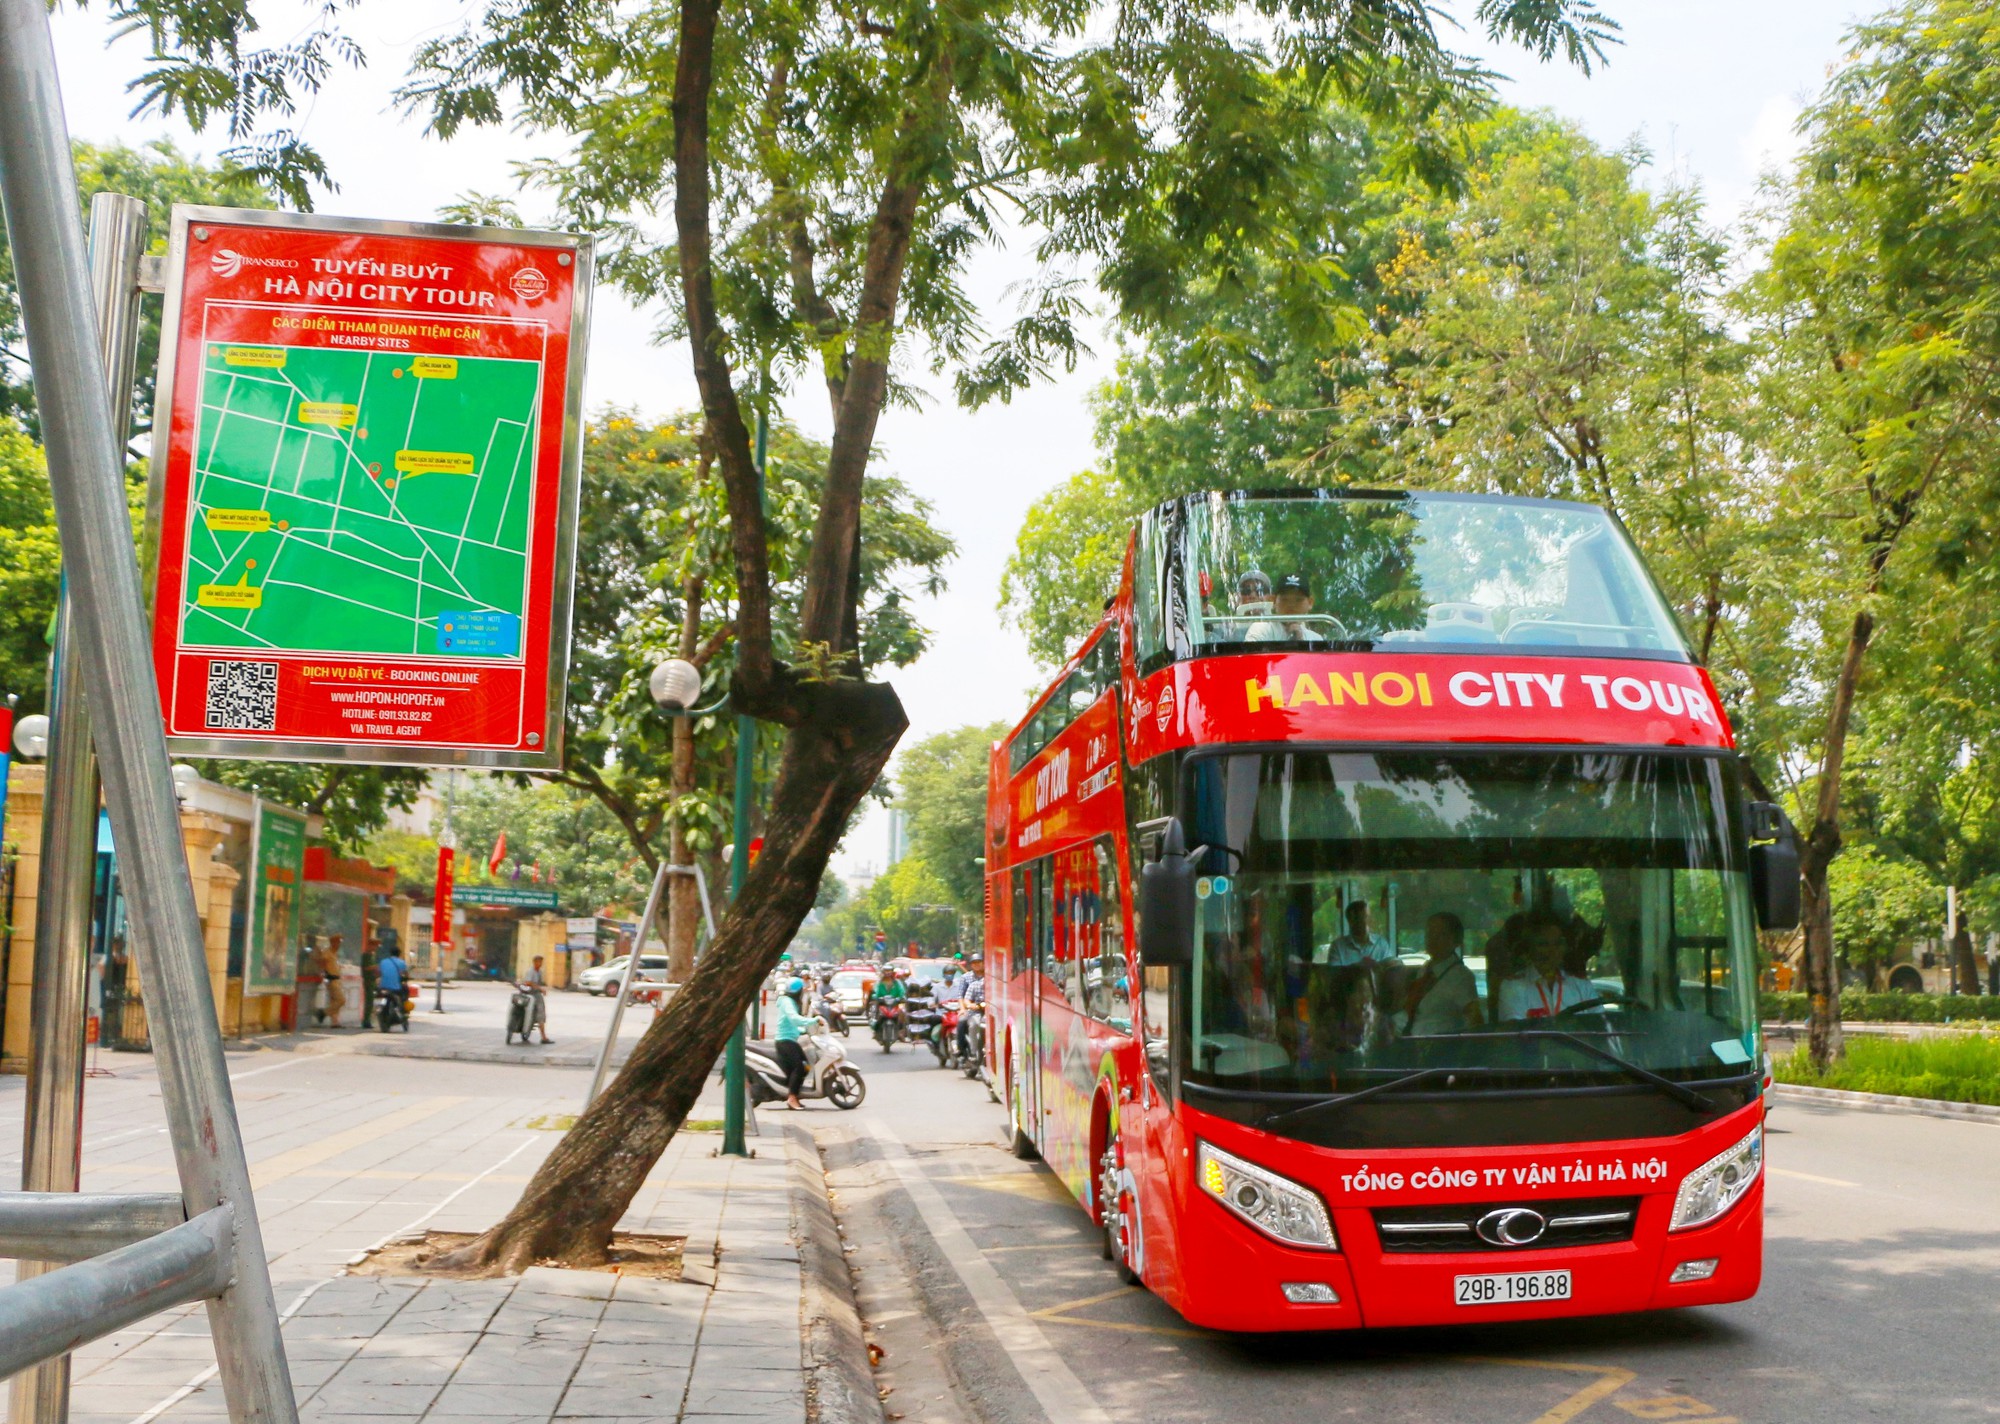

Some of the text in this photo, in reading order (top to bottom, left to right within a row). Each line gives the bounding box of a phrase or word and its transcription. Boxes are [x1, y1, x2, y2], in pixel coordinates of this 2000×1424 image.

[241, 256, 299, 268] TRANSERCO
[311, 257, 453, 281] TUYẾN BUÝT
[264, 276, 495, 307] HÀ NỘI CITY TOUR
[272, 315, 481, 341] CÁC ĐIỂM THAM QUAN TIỆM CẬN
[331, 334, 410, 349] NEARBY SITES
[303, 666, 330, 680] DỊCH
[332, 667, 347, 681] VỤ
[369, 667, 384, 680] VÉ
[390, 670, 440, 683] BOOKING
[442, 672, 480, 684] ONLINE
[1244, 670, 1713, 726] HANOI CITY TOUR
[342, 708, 432, 722] HOTLINE: 0911.93.82.82
[351, 723, 421, 736] VIA TRAVEL AGENT
[1341, 1156, 1668, 1192] TỔNG CÔNG TY VẬN TẢI HÀ NỘI
[1457, 1273, 1569, 1303] 29B-196.88
